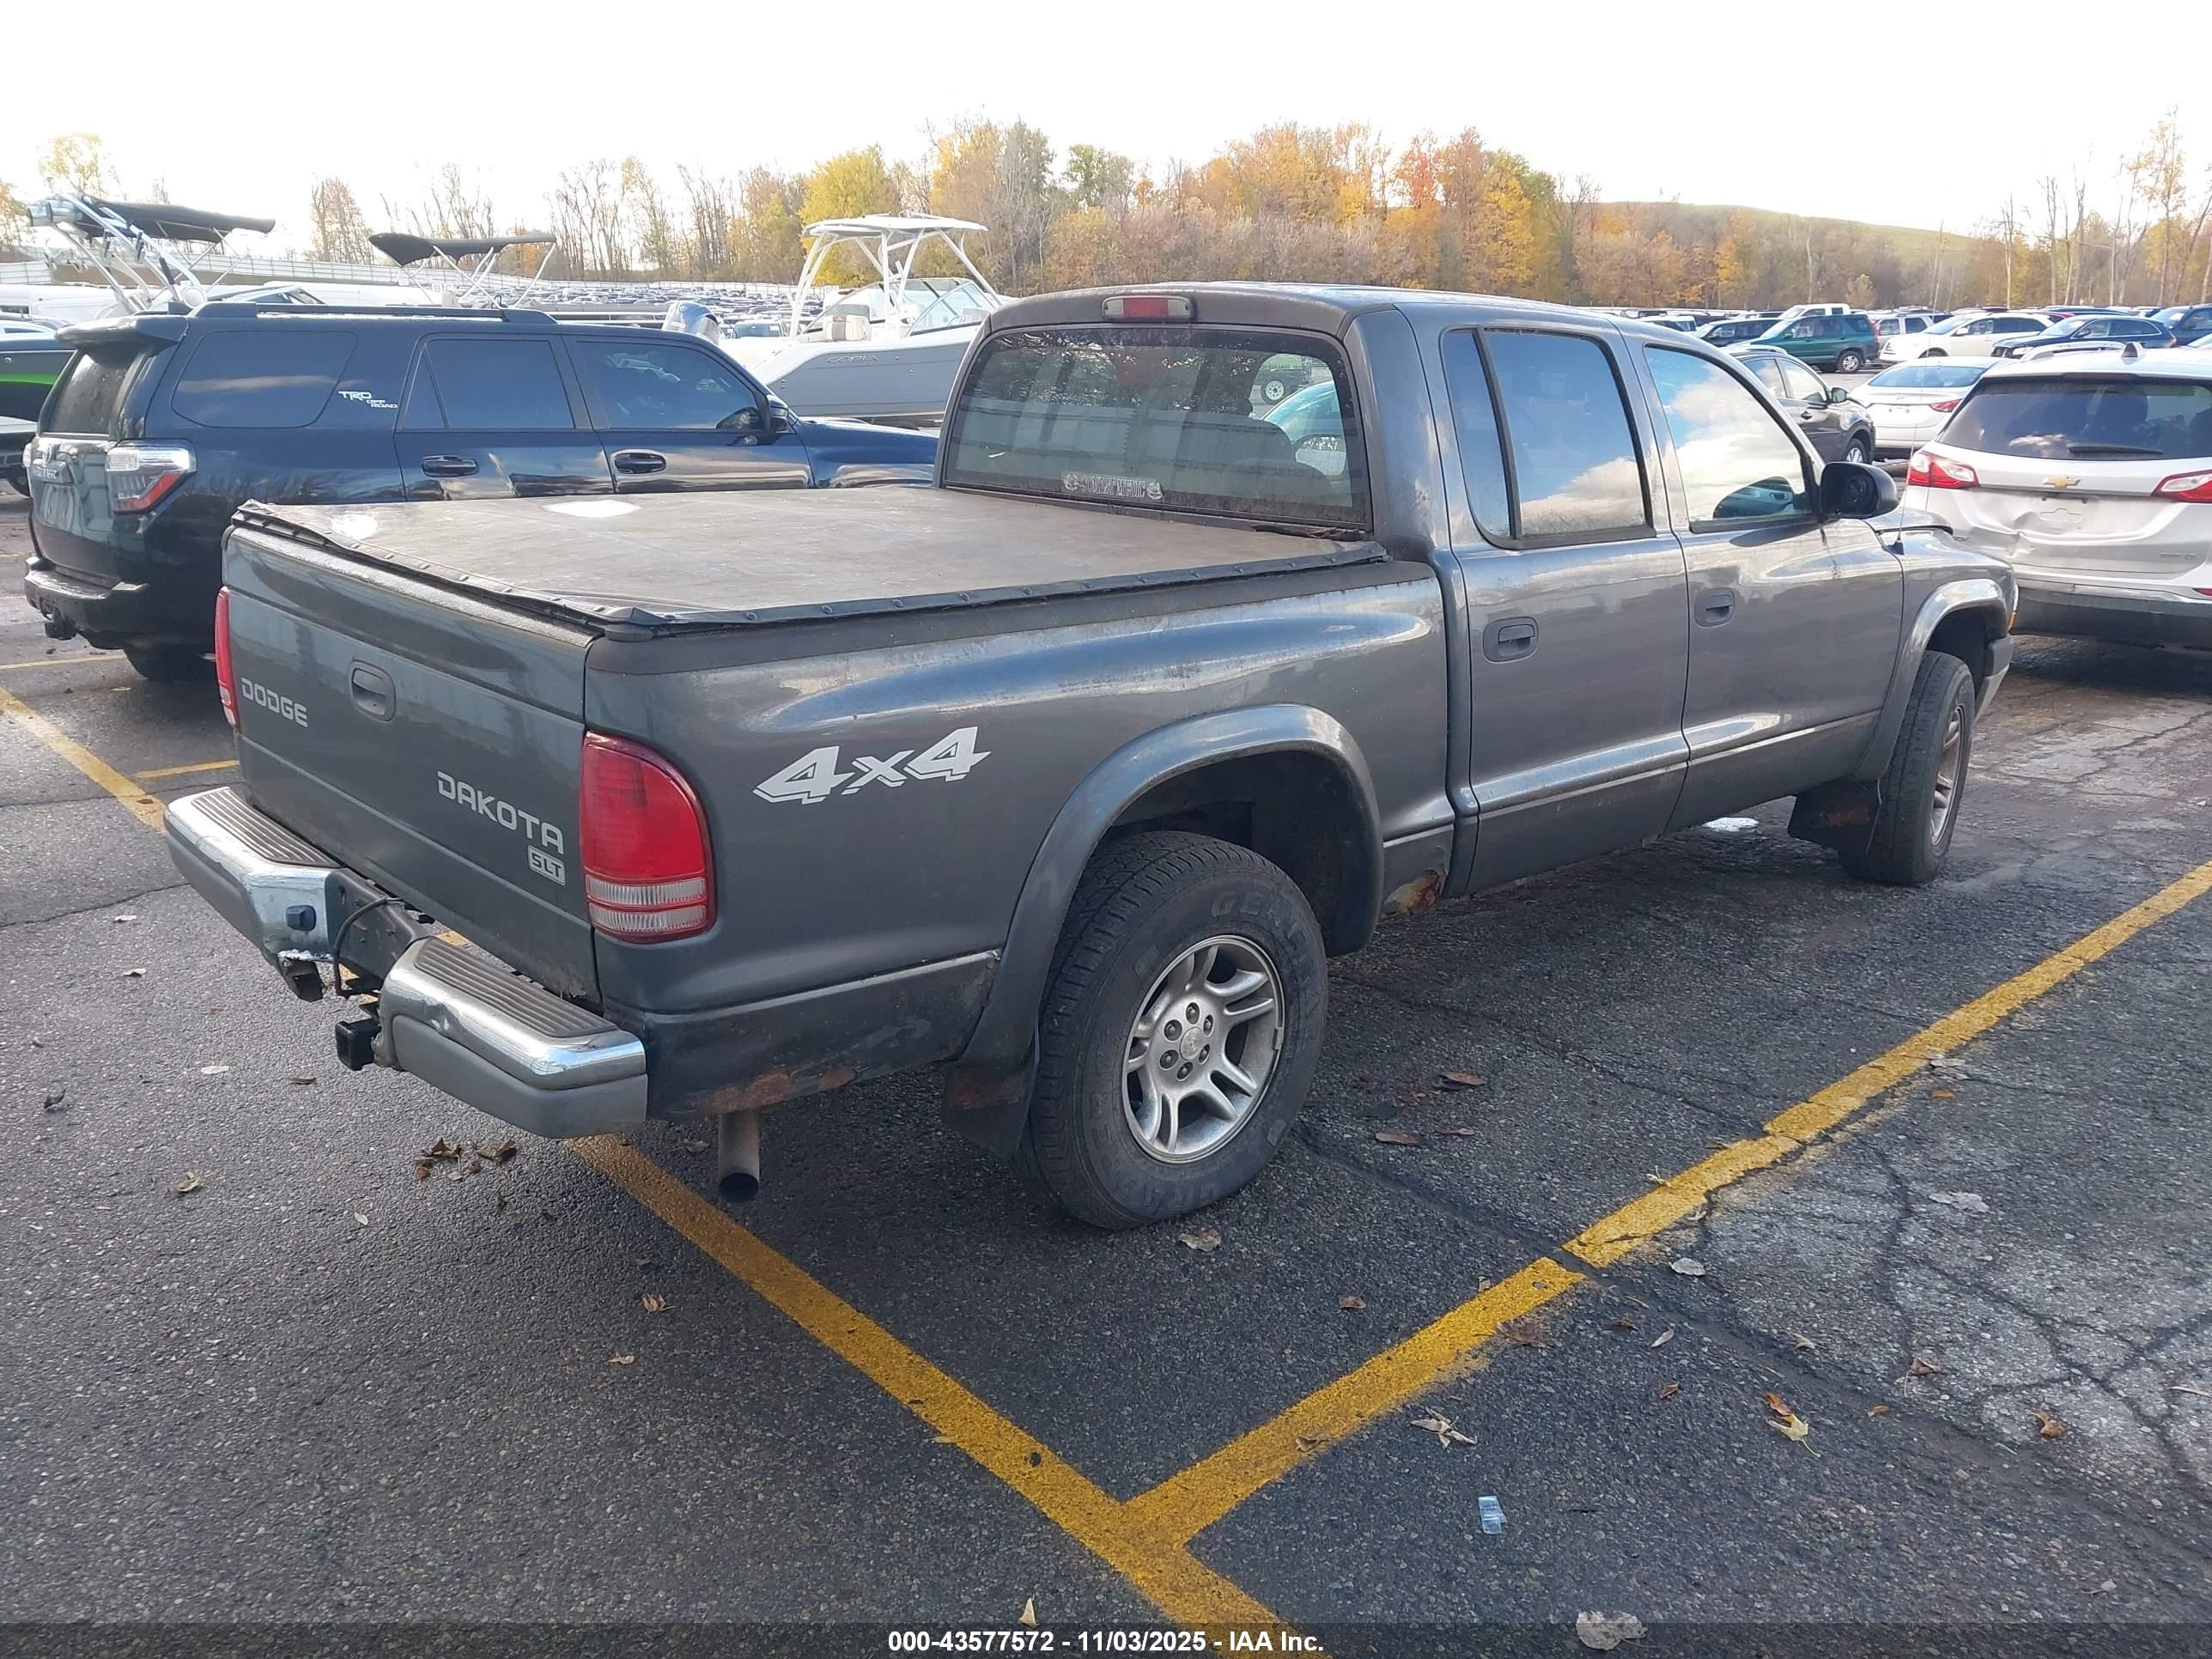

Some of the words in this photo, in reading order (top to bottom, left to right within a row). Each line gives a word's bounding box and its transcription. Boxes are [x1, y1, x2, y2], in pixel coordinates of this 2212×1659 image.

[337, 391, 372, 401] TRD
[240, 677, 308, 728] DODGE
[436, 770, 564, 855] DAKOTA
[530, 850, 563, 880] SLT
